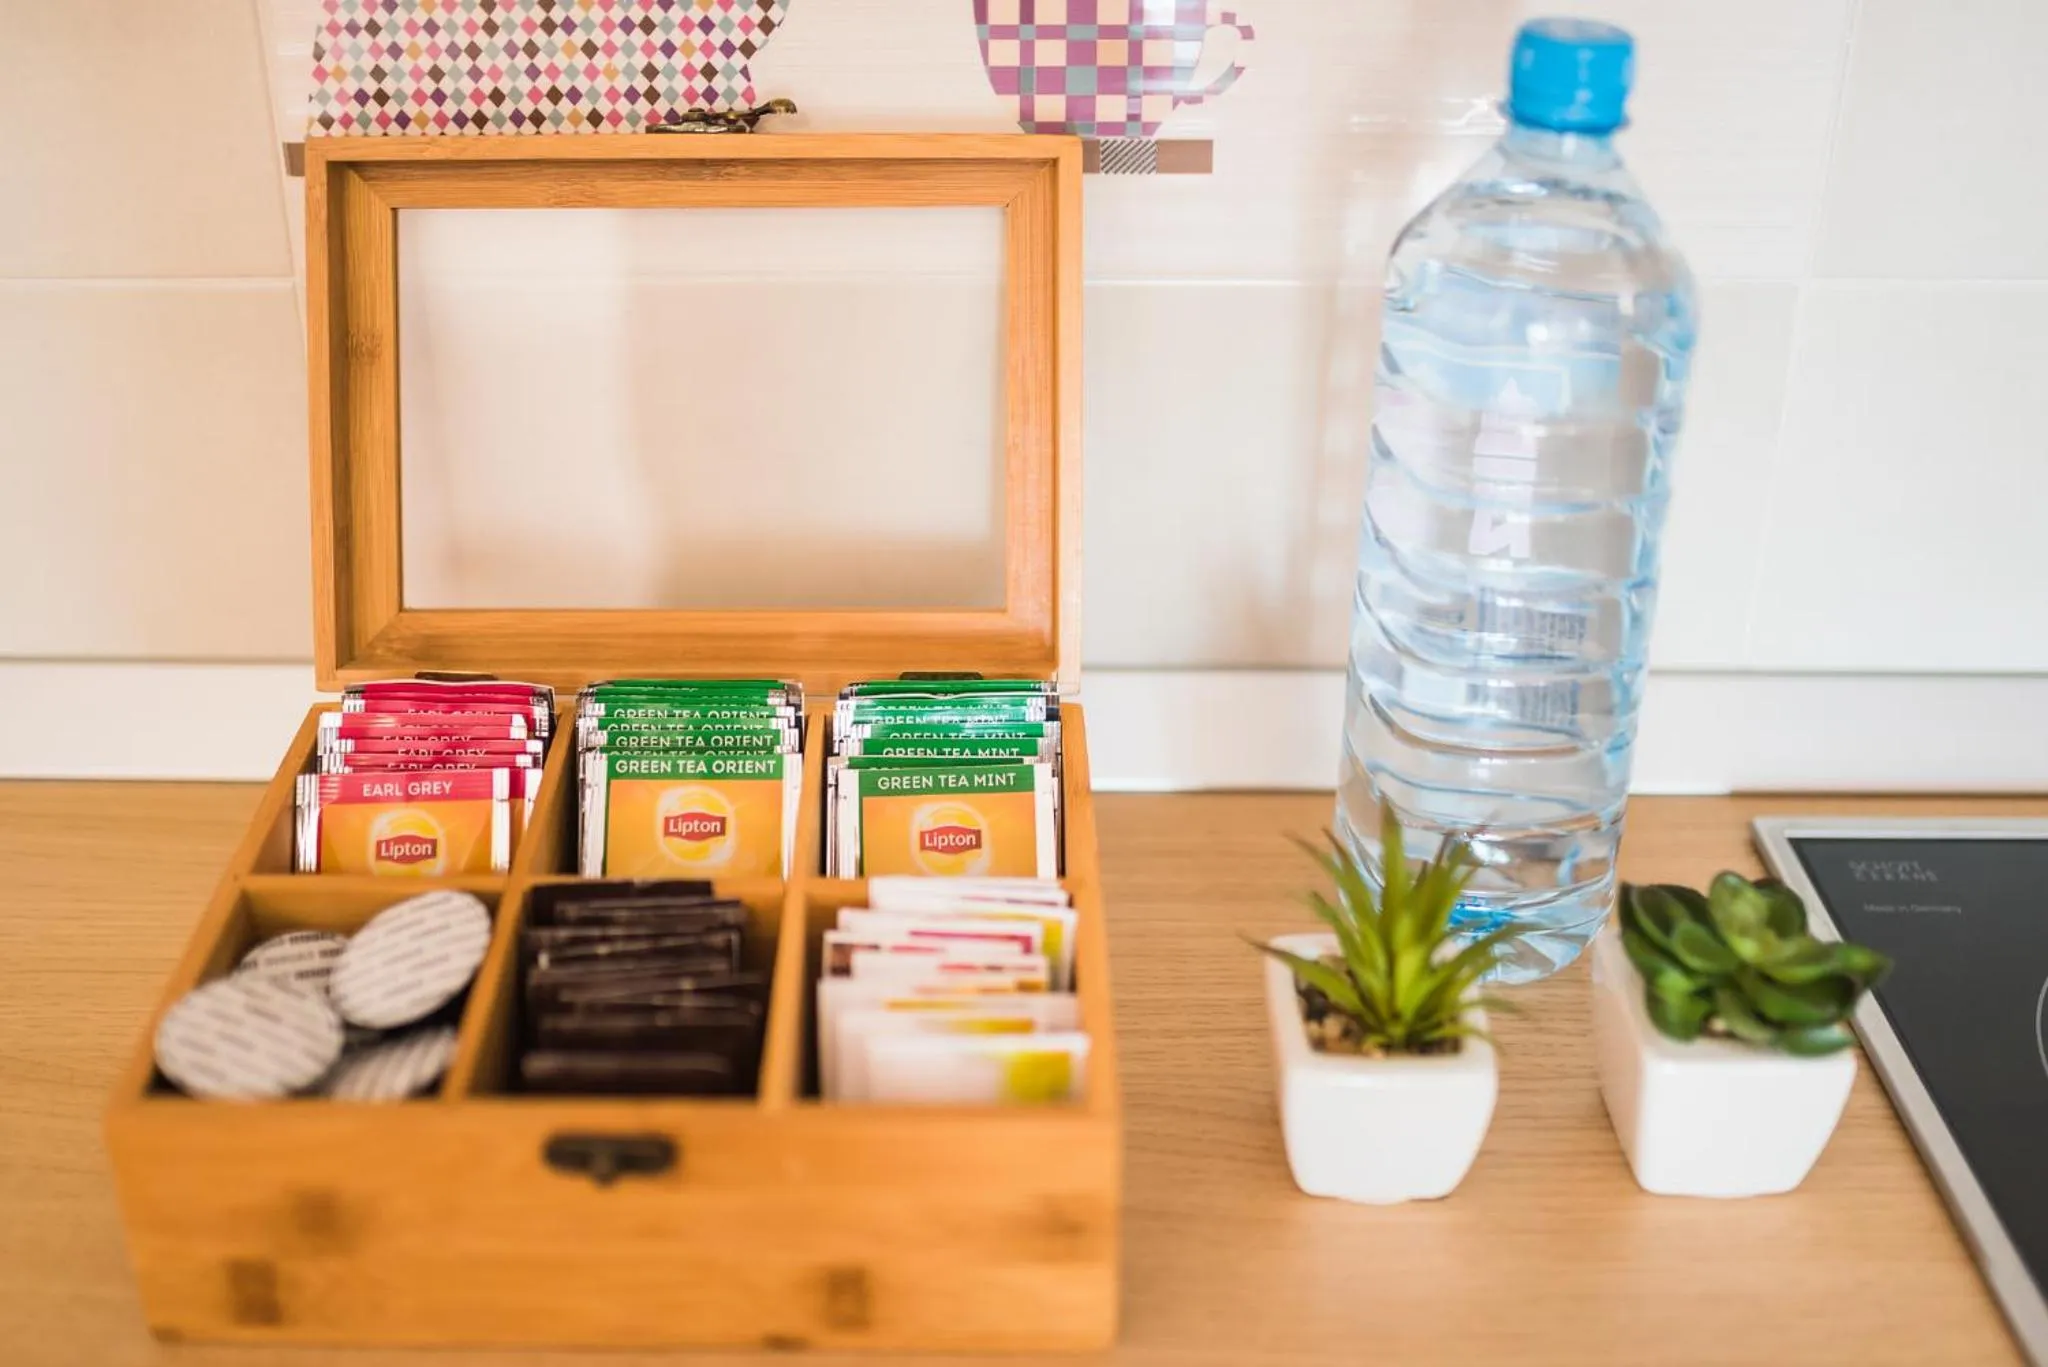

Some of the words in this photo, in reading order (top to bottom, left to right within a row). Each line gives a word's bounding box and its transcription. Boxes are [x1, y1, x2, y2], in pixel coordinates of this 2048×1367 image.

[613, 709, 668, 718] GREEN
[672, 710, 702, 718] TEA
[708, 710, 770, 719] ORIENT
[615, 735, 670, 747] GREEN
[675, 735, 706, 747] TEA
[710, 735, 774, 747] ORIENT
[883, 747, 937, 757] GREEN
[942, 747, 971, 757] TEA
[977, 747, 1020, 757] MINT
[615, 760, 672, 773] GREEN
[676, 760, 708, 773] TEA
[712, 760, 777, 773] ORIENT
[362, 784, 403, 797] EARL
[408, 781, 453, 796] GREY
[877, 775, 933, 790] GREEN
[938, 774, 969, 788] TEA
[974, 772, 1017, 787] MINT
[668, 818, 721, 837] Lipton
[924, 831, 976, 849] Lipton
[381, 842, 433, 860] Lipton
